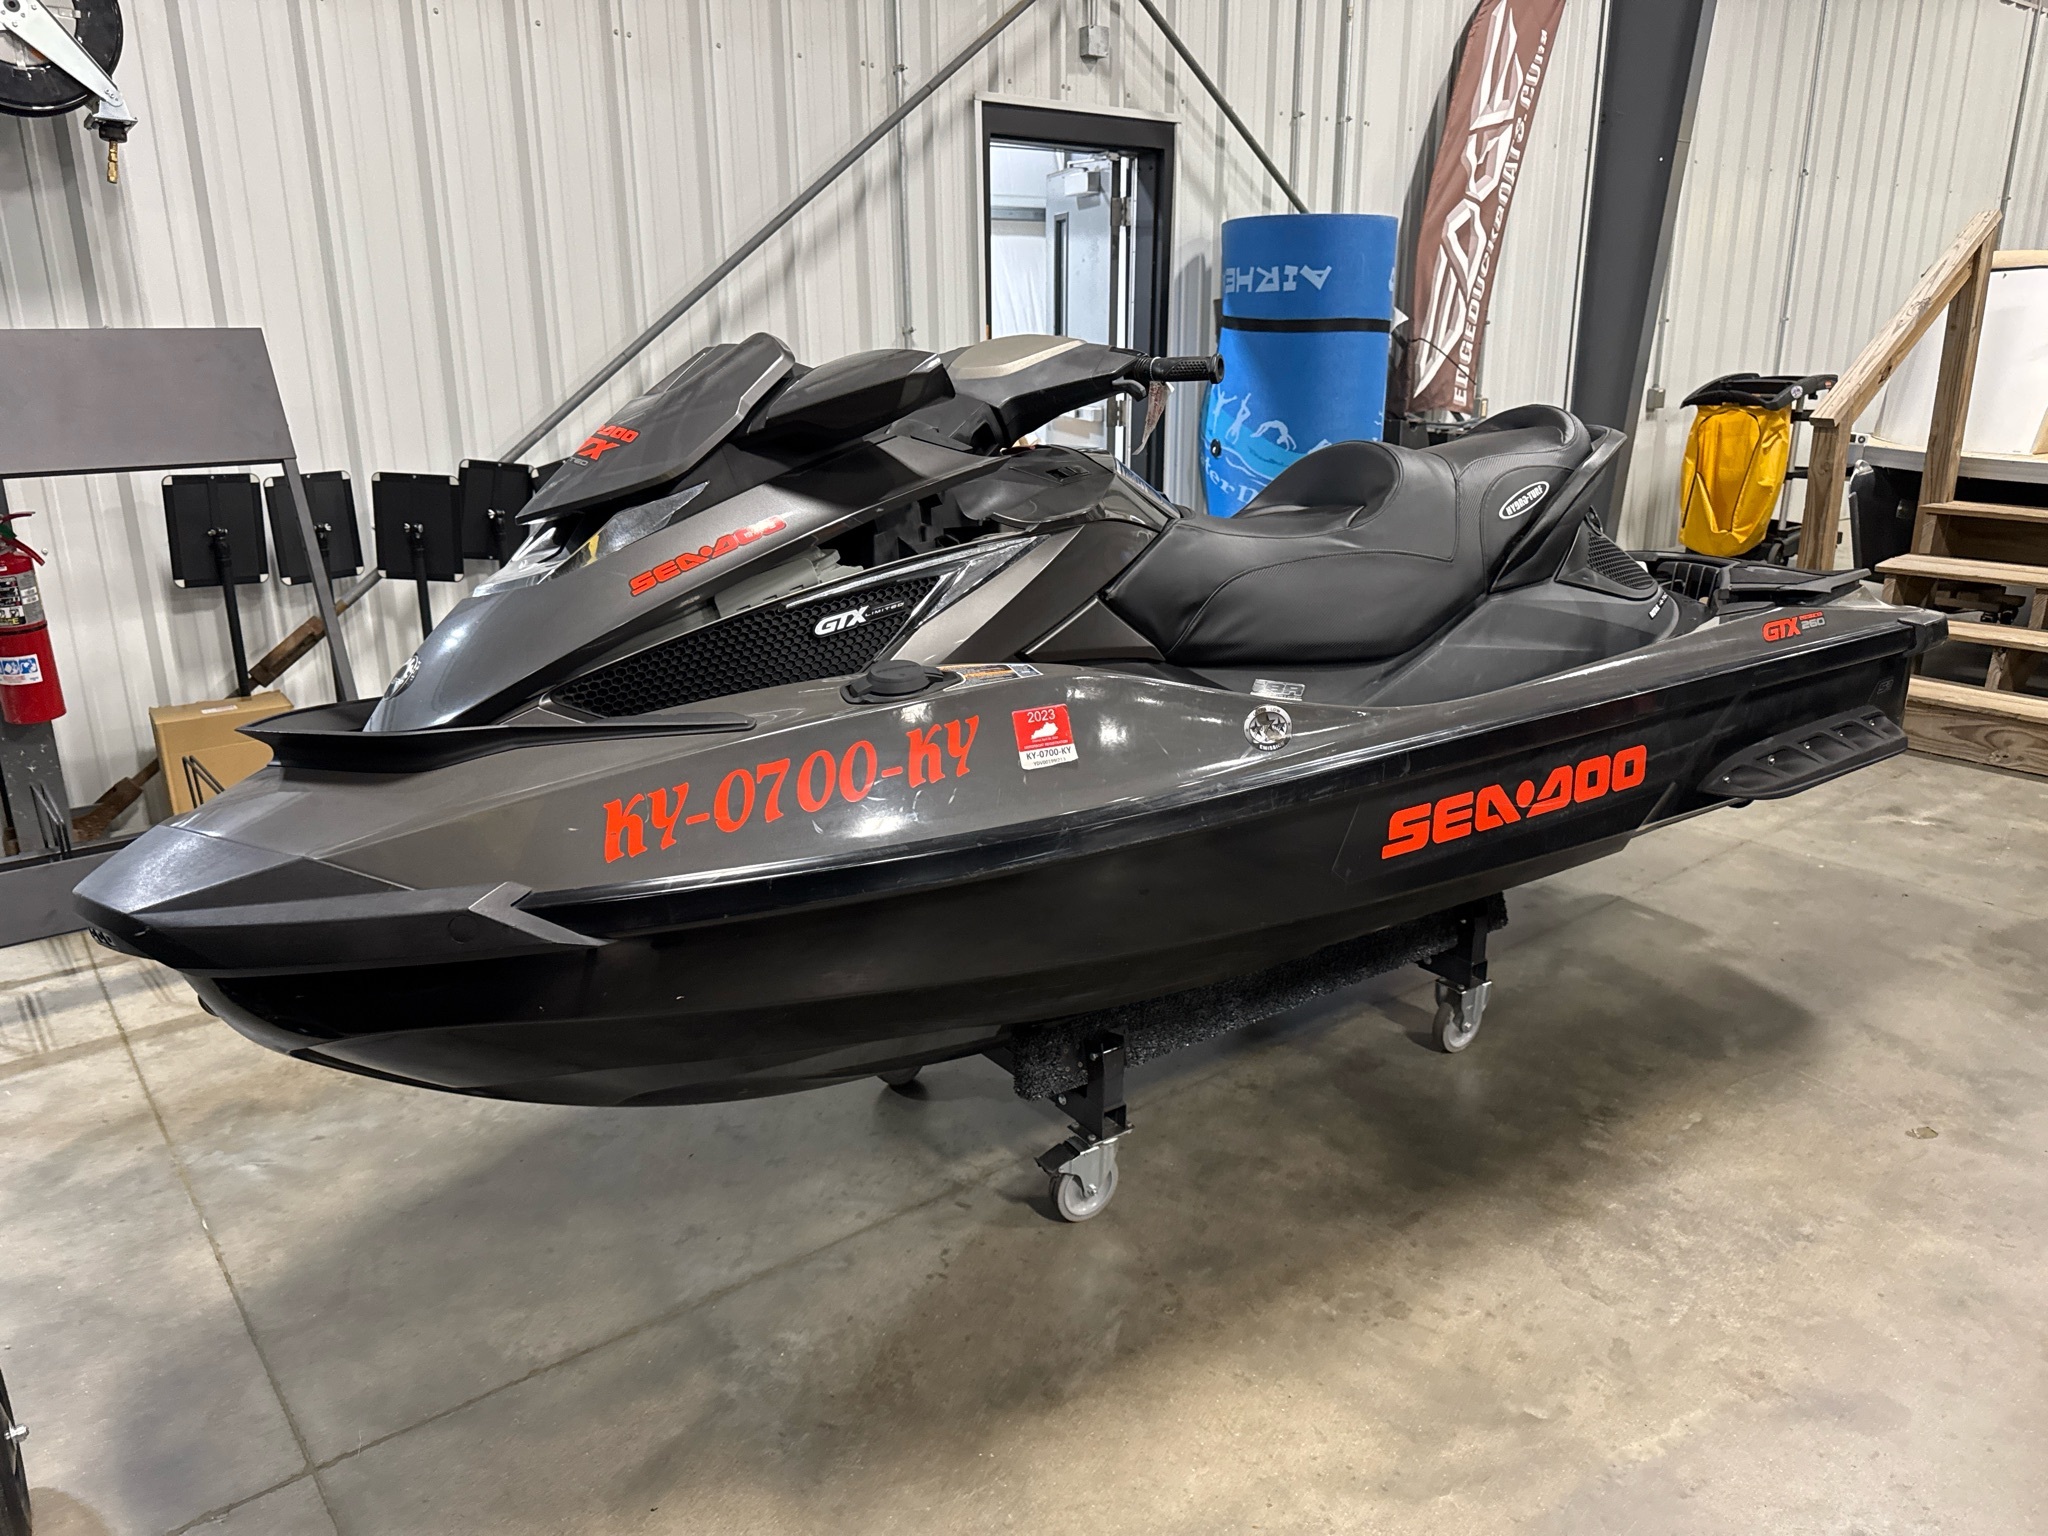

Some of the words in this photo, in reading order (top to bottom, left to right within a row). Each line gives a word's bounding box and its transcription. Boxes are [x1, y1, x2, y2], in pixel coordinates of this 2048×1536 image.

[1412, 0, 1525, 400] EDGE
[813, 604, 870, 637] GTX
[1761, 616, 1803, 644] GTX
[1800, 616, 1826, 631] 260
[1027, 709, 1056, 723] 2023
[1025, 745, 1072, 761] KY-0700-KY
[603, 714, 981, 865] KY-0700-KY
